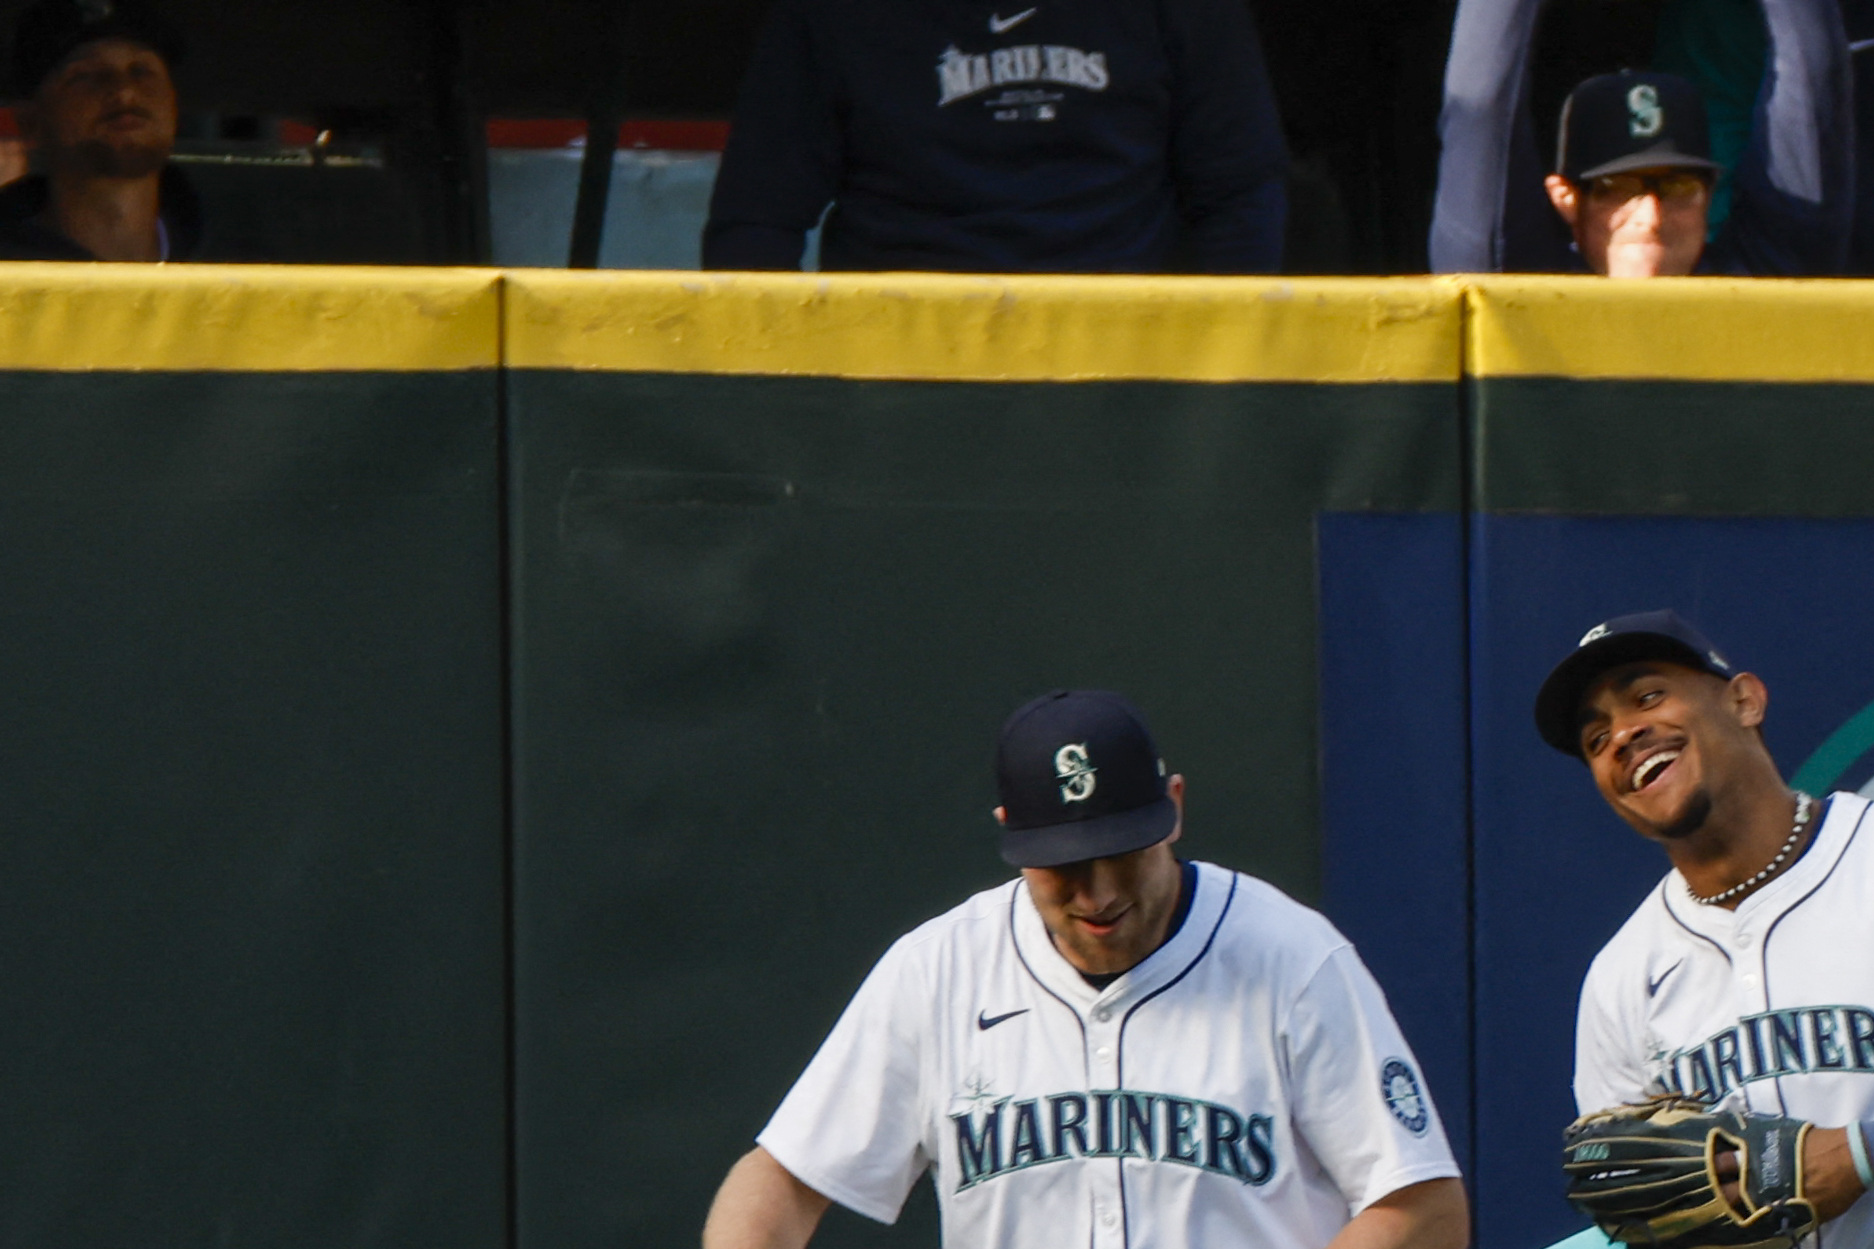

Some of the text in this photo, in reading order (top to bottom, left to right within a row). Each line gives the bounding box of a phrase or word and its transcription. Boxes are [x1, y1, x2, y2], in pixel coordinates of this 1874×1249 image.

[935, 43, 1110, 107] MARINERS
[1627, 84, 1664, 138] S
[1053, 741, 1099, 804] S
[948, 1088, 1276, 1195] MARINERS
